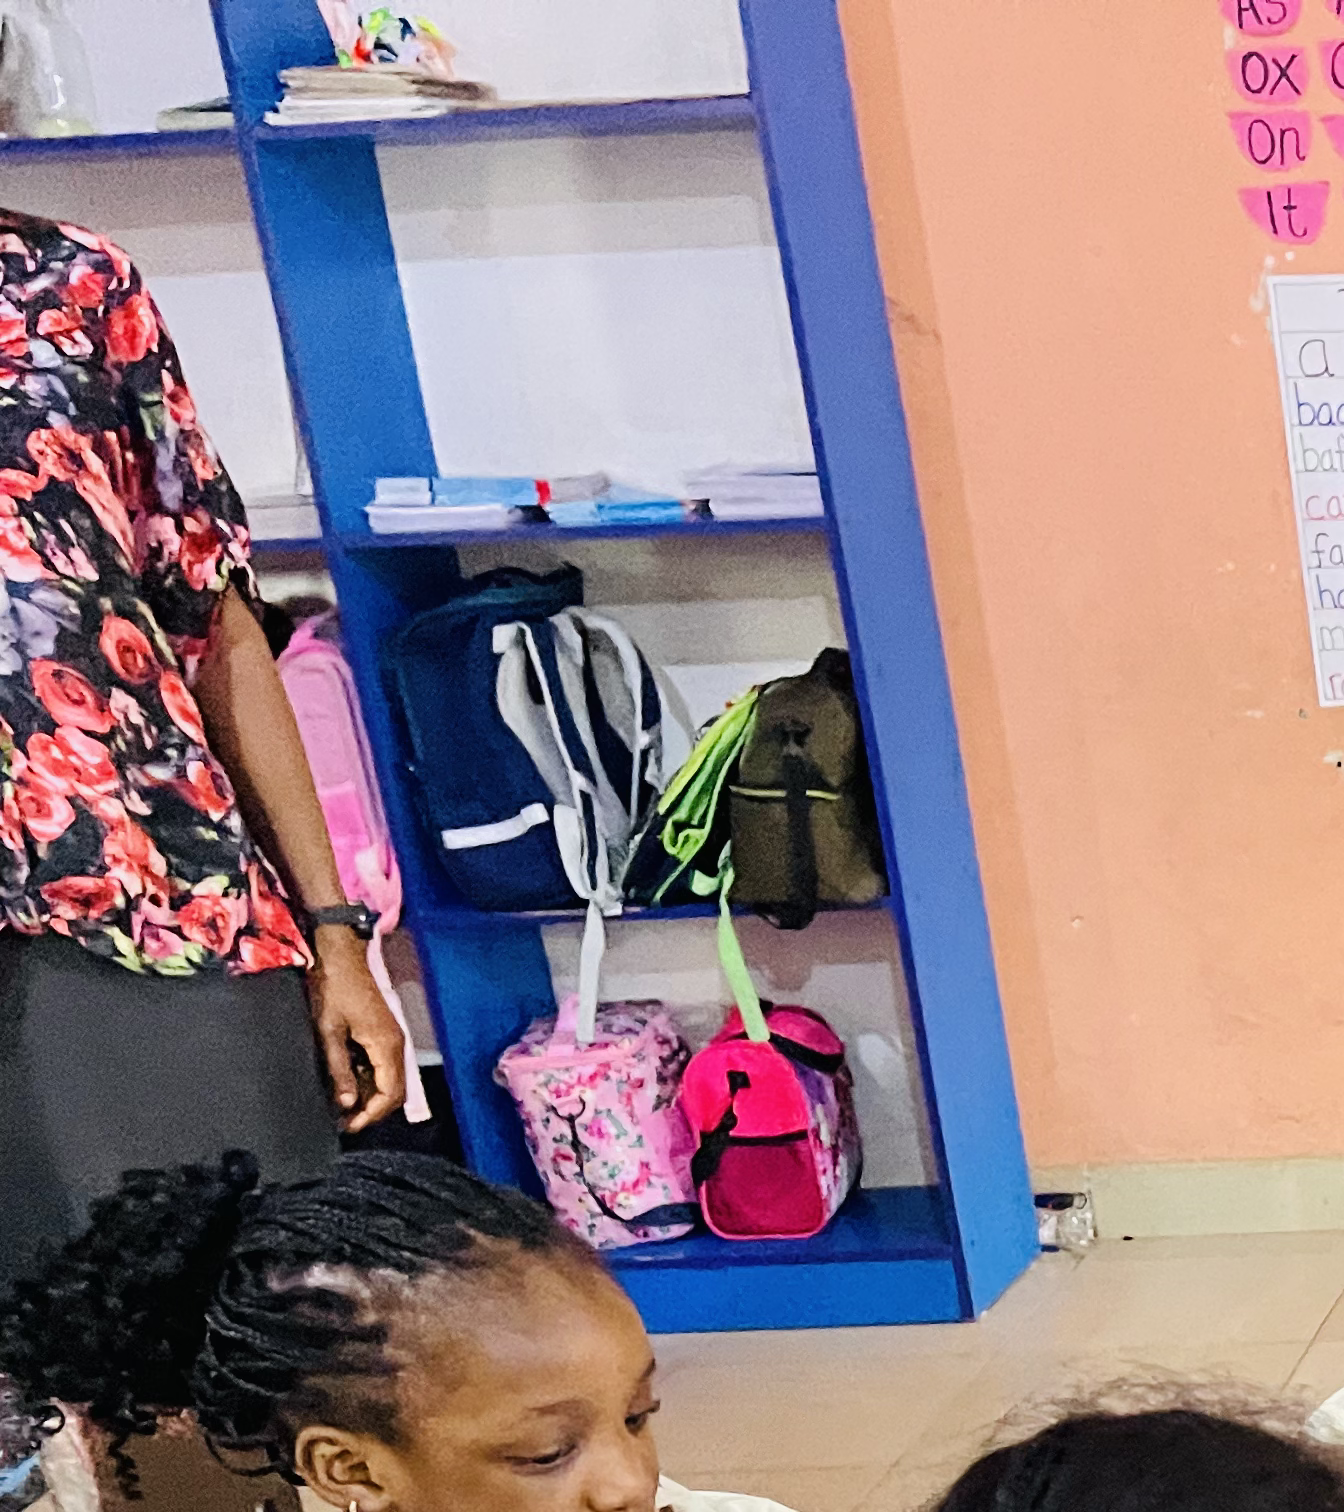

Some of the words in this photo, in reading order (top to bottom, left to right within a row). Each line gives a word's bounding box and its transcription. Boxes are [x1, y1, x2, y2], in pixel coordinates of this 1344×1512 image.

[1247, 120, 1306, 165] On
[1267, 188, 1302, 237] It
[1300, 339, 1334, 377] a
